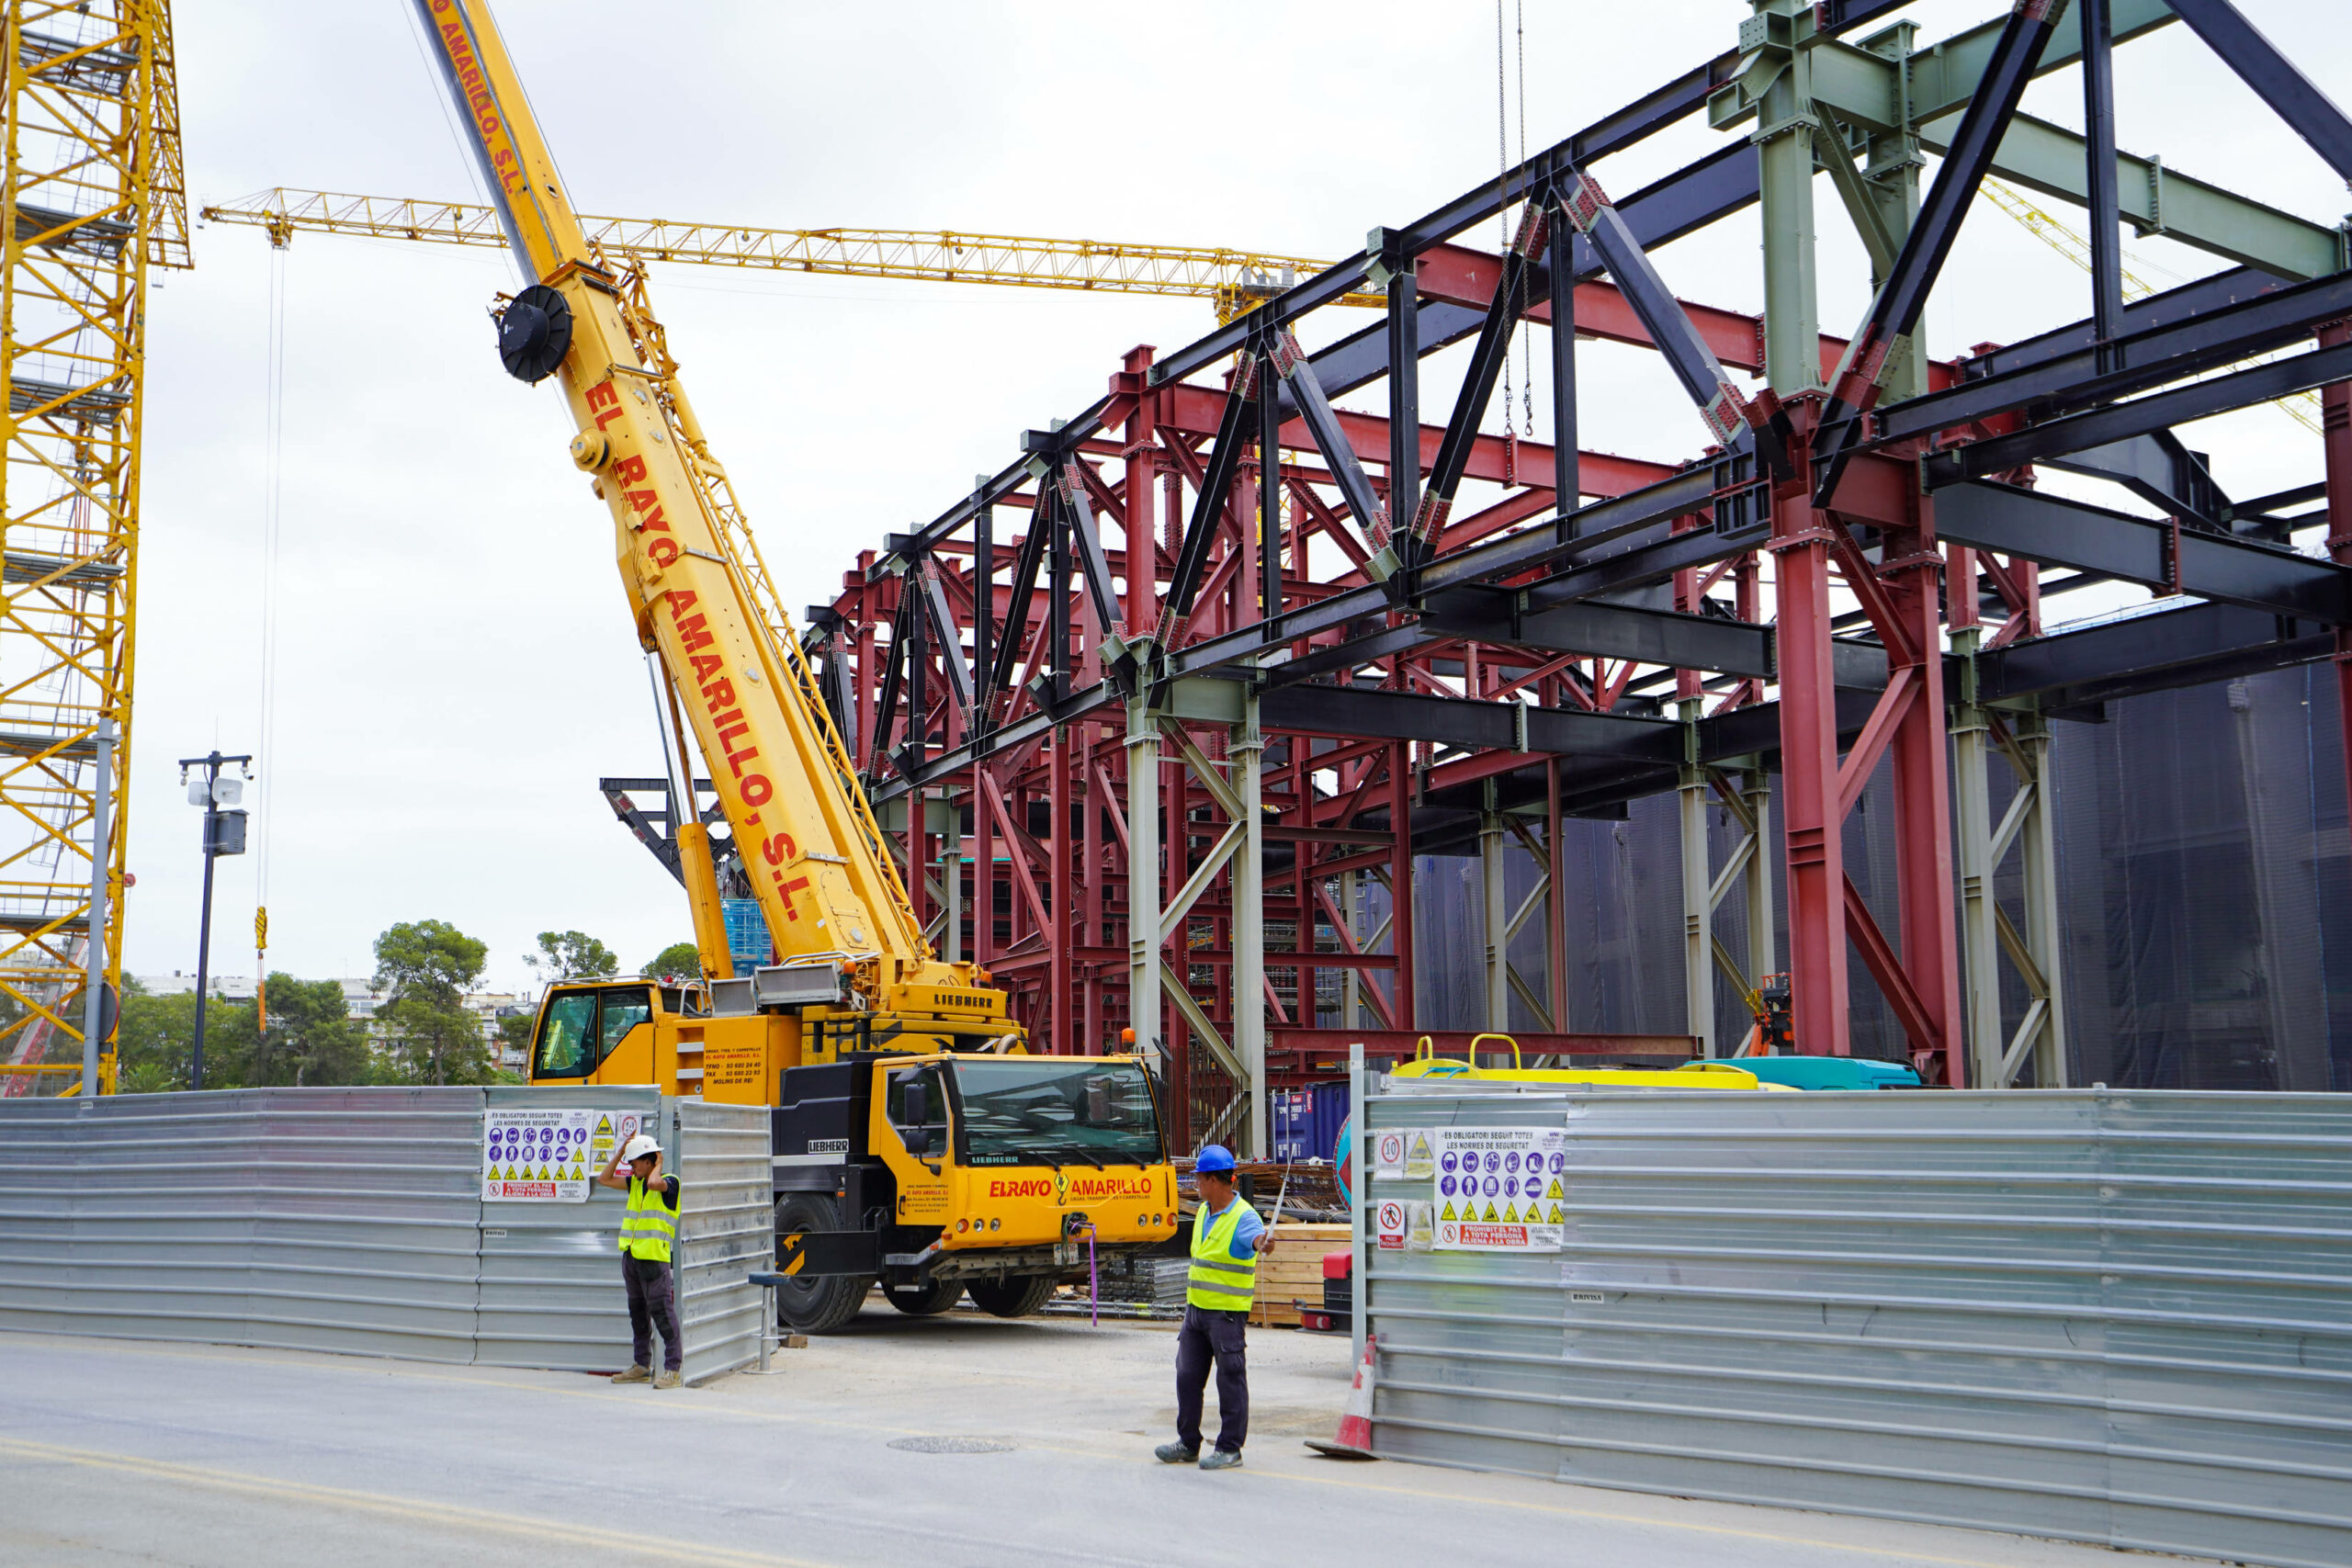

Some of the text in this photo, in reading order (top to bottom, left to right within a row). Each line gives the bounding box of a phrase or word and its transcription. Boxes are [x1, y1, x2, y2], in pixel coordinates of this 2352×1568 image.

[442, 23, 500, 145] AMARILLO,
[494, 148, 519, 194] S.L.
[585, 380, 810, 922] EL RAYO AMARILLO, S.L.
[934, 994, 992, 1009] LIEBHERR
[809, 1141, 848, 1152] LIEBHERR
[1385, 1142, 1396, 1156] 10
[1071, 1179, 1152, 1195] AMARILLO
